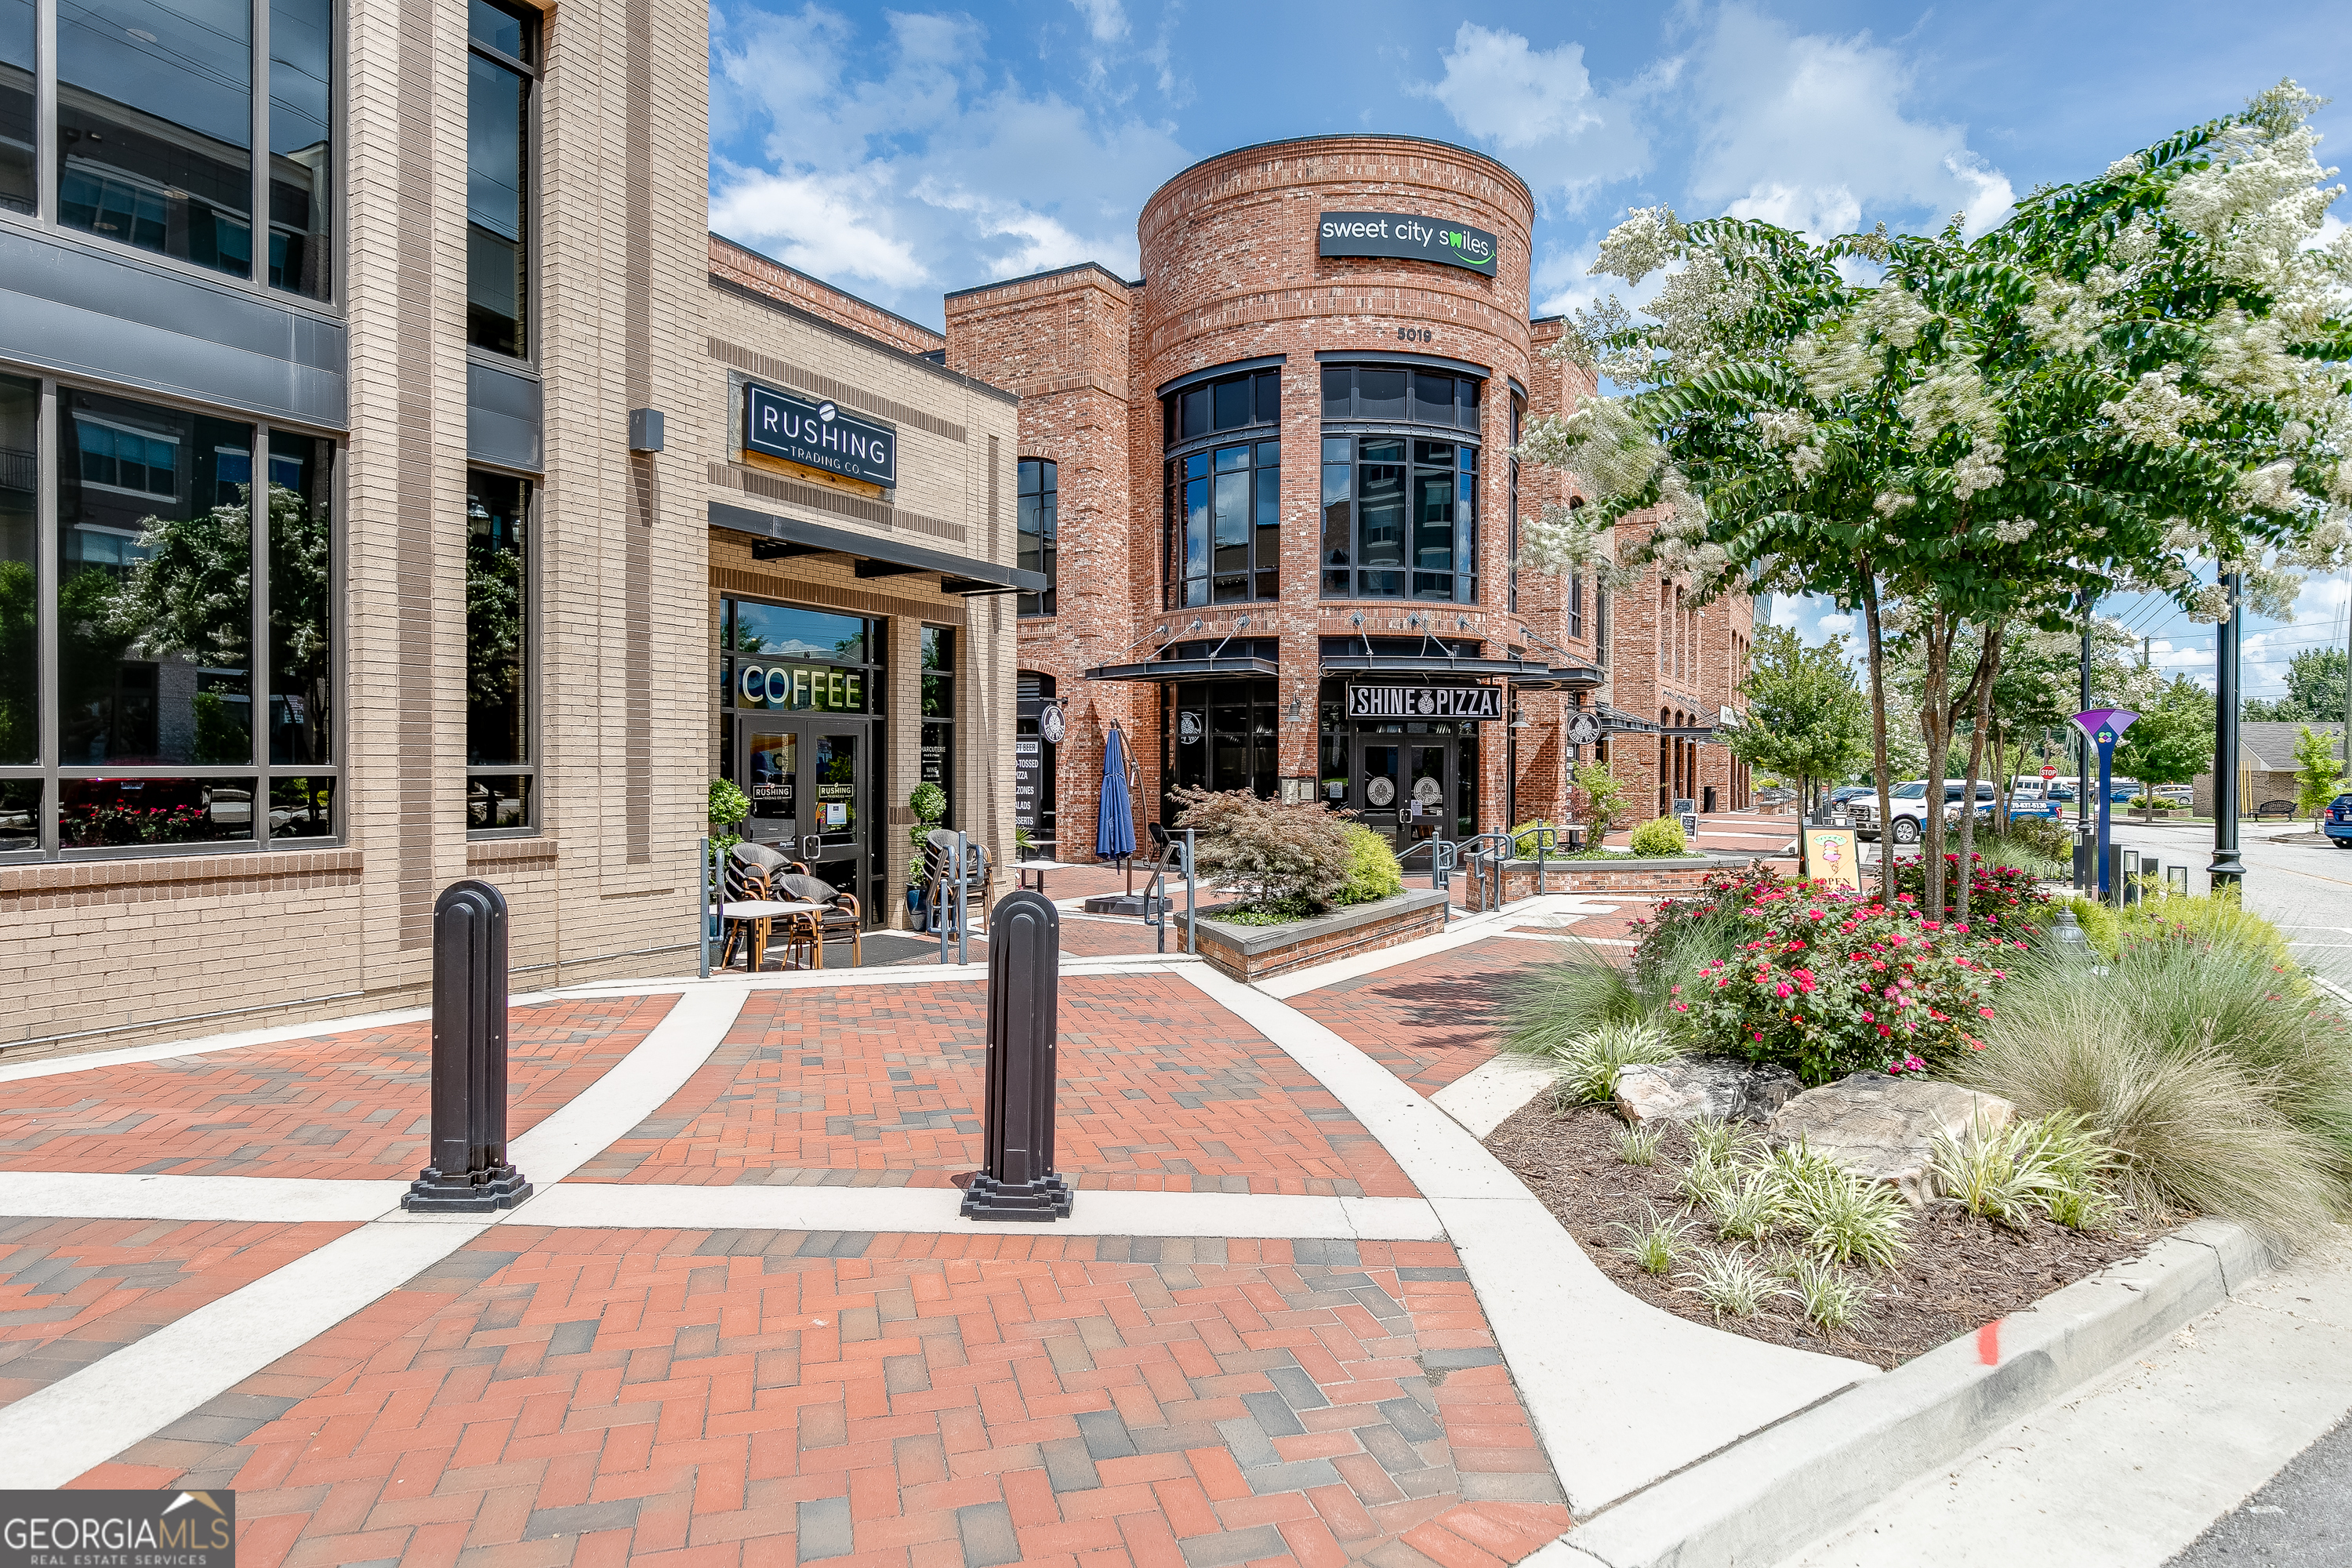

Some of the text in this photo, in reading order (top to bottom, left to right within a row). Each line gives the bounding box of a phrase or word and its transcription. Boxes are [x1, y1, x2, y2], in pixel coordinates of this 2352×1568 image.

[1322, 219, 1388, 238] sweet
[1395, 220, 1434, 248] city
[1397, 326, 1432, 343] 5019
[763, 404, 885, 464] RUSHING
[790, 445, 861, 475] TRADING CO.
[742, 665, 860, 708] COFFEE
[1357, 688, 1493, 715] SHINE PIZZA
[1570, 728, 1599, 742] SHINE PIZZA
[1023, 743, 1036, 752] BEER
[1016, 771, 1028, 779] IZZA
[821, 786, 851, 795] RUSHING
[1016, 786, 1034, 795] ZONES
